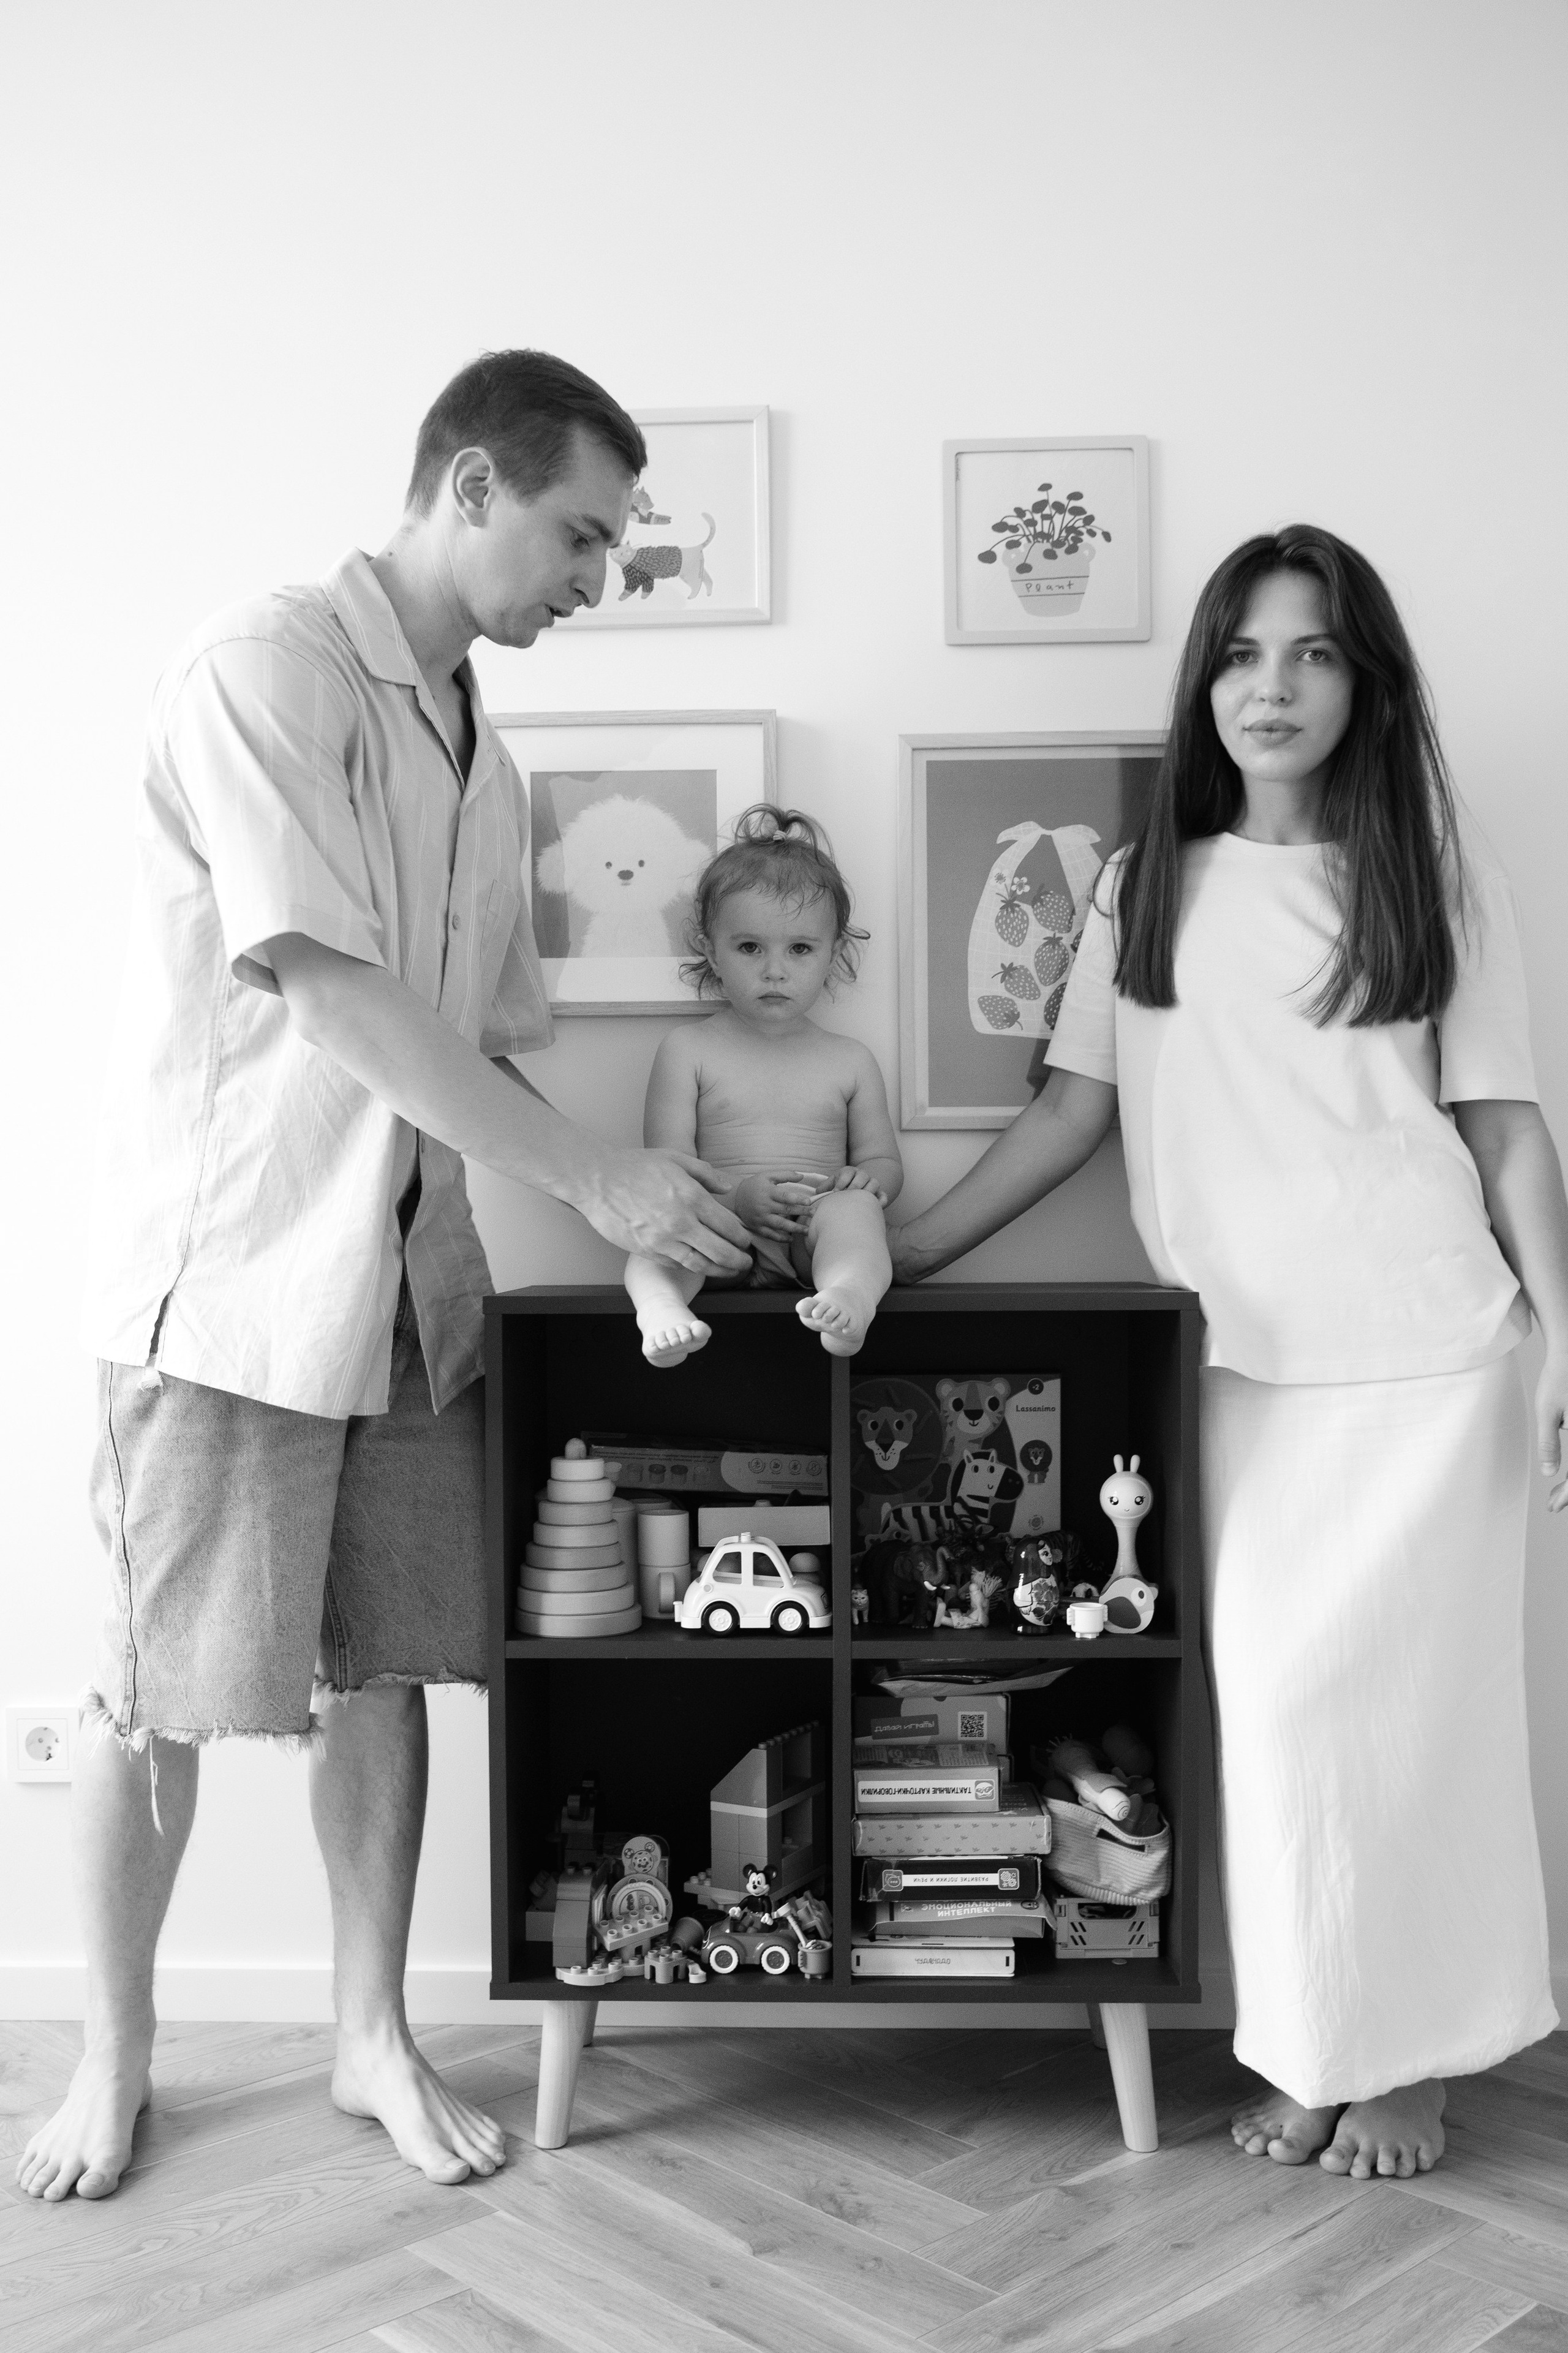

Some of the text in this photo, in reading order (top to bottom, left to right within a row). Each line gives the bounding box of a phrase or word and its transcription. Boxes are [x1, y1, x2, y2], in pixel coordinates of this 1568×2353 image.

[874, 1724, 902, 1733] Давай
[861, 1787, 930, 1796] КАРТОЧКИ-ГОВОРИЛКИ
[921, 1901, 1012, 1911] ЭМОЦИОНАЛЬНЫЙ
[937, 1906, 996, 1917] ИНТЕЛЛЕКТ
